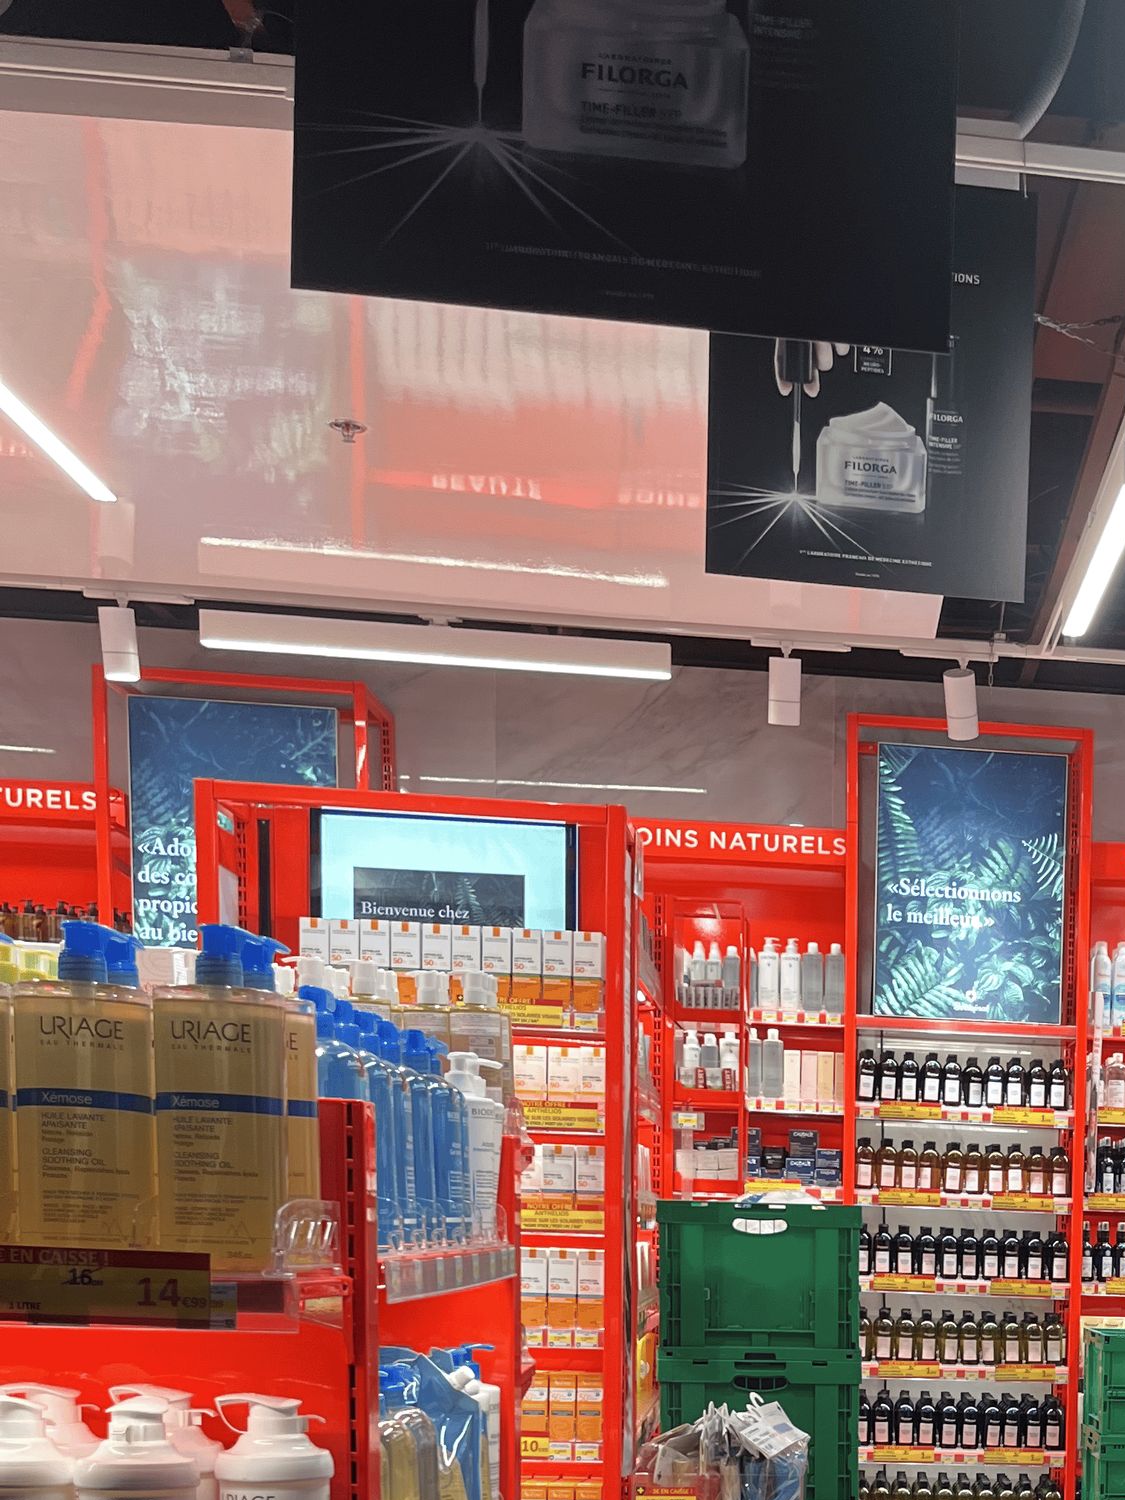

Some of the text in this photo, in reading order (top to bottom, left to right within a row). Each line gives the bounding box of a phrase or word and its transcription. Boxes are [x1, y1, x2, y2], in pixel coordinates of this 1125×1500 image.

[581, 62, 689, 90] FILORGA
[952, 272, 980, 285] IONS
[844, 461, 897, 474] FILORGA
[0, 788, 96, 810] URELS
[138, 838, 196, 858] «Ado
[710, 831, 846, 856] NATURELS
[138, 864, 170, 884] des
[887, 878, 1021, 903] «Sélectionnons
[361, 901, 470, 919] Bienvenue chez
[887, 904, 902, 921] le
[140, 925, 163, 941] au
[39, 1015, 124, 1040] URIAGE
[171, 1020, 251, 1043] URIAGE
[41, 1091, 92, 1105] Xémose
[171, 1095, 219, 1109] Xémose
[10, 1249, 98, 1266] EN CAISSE
